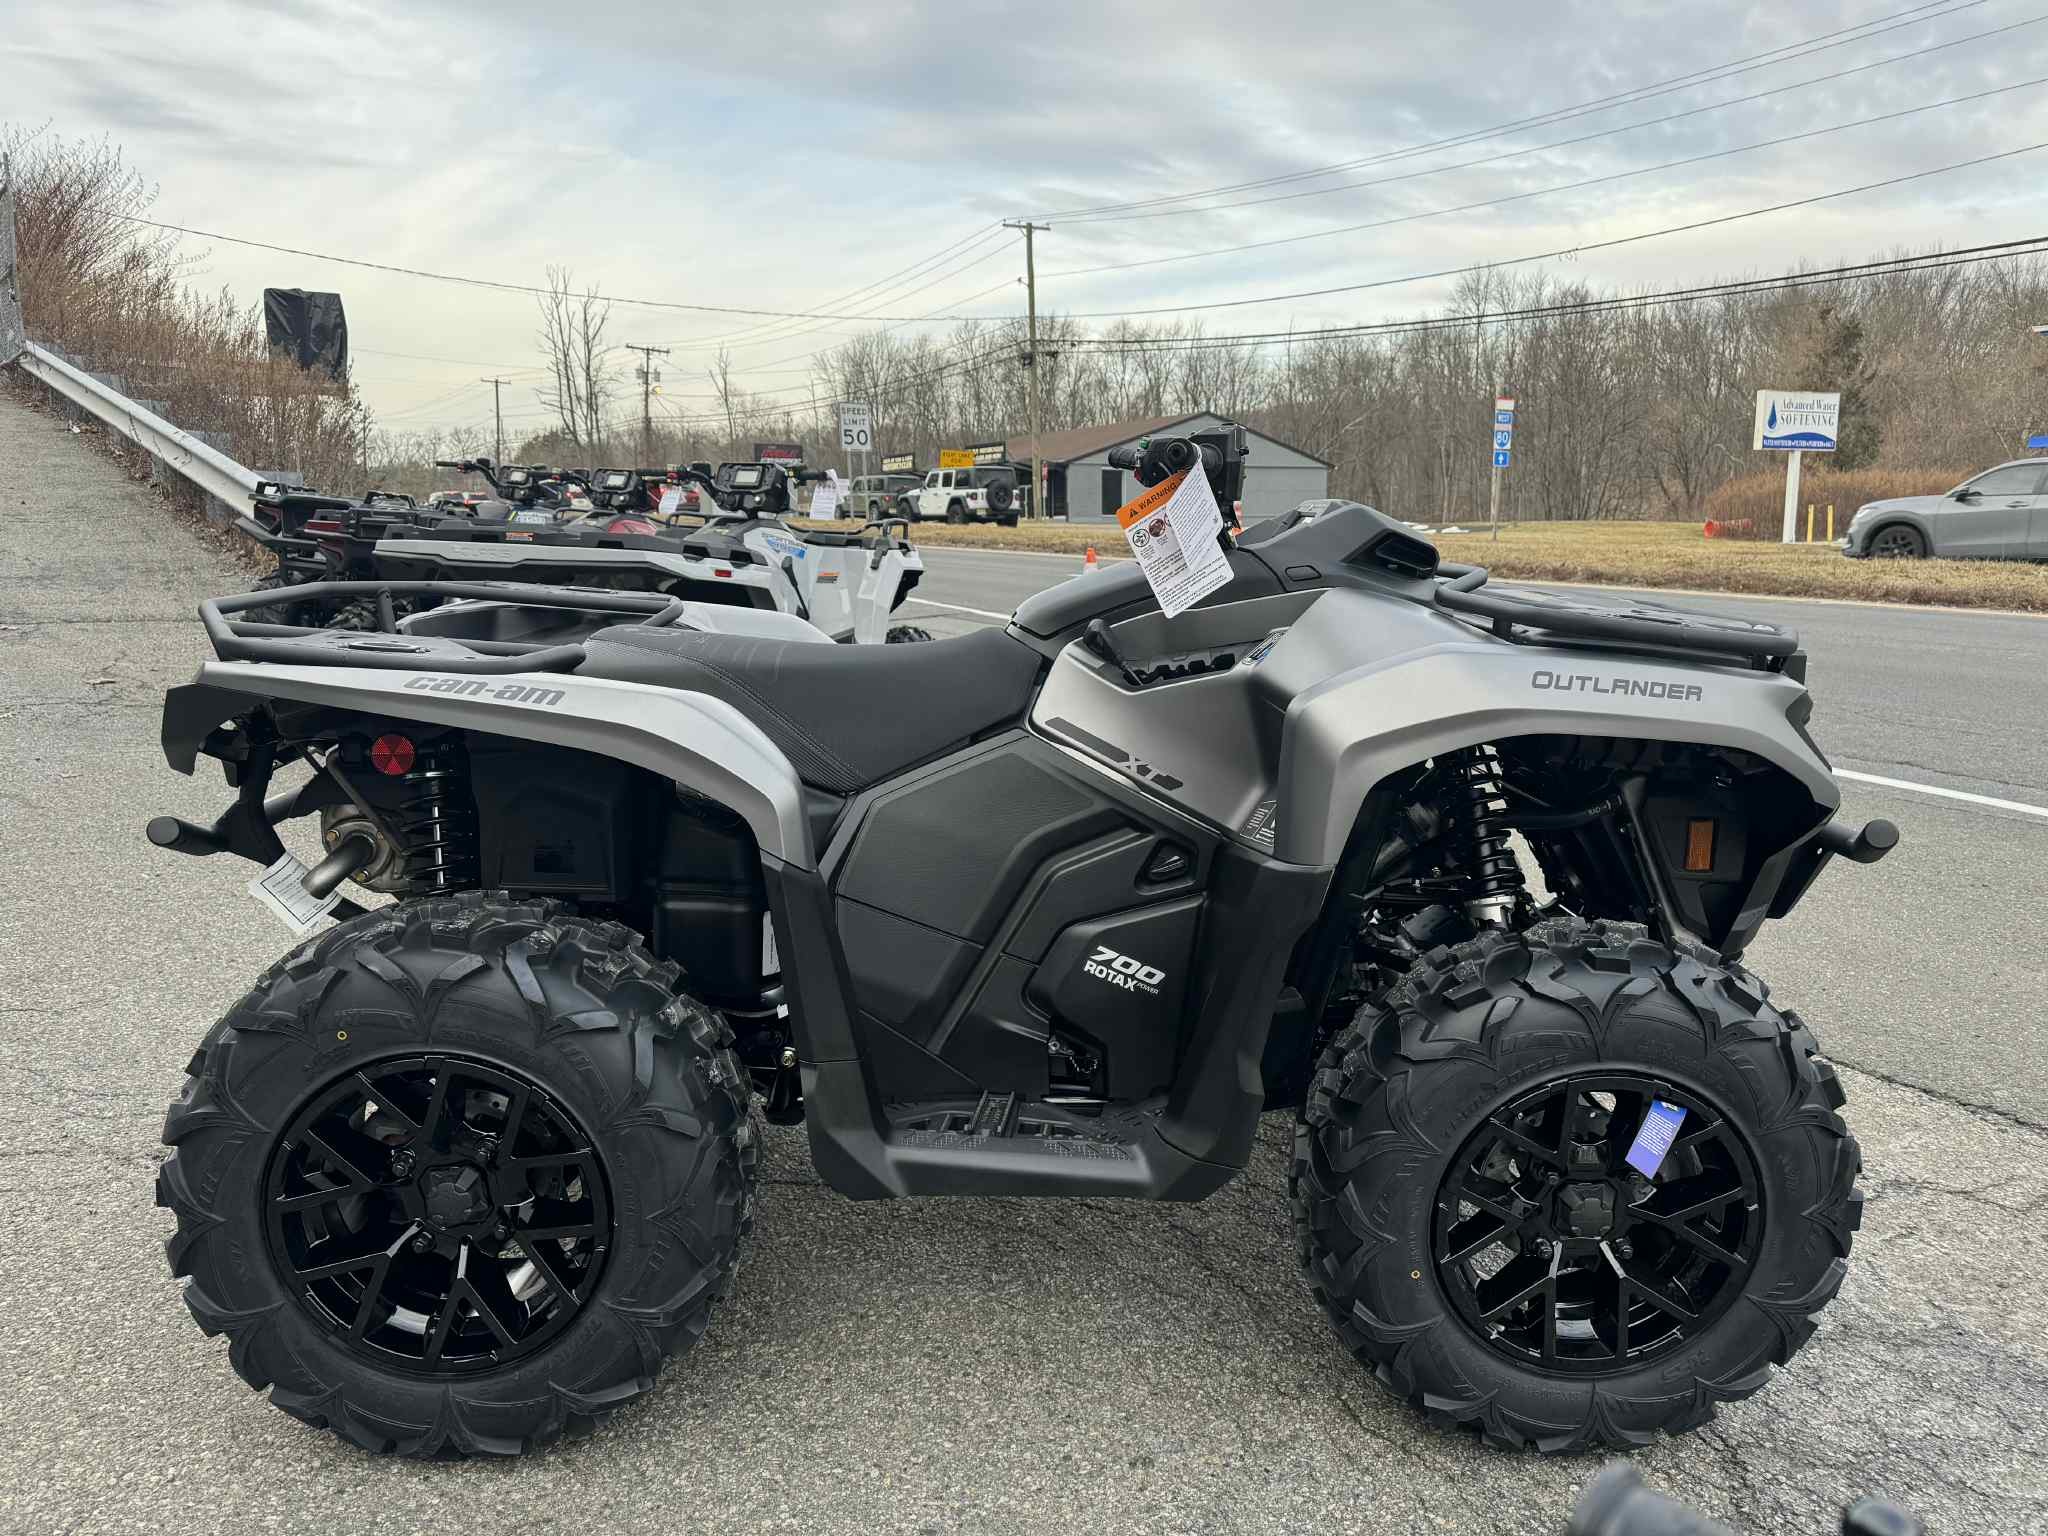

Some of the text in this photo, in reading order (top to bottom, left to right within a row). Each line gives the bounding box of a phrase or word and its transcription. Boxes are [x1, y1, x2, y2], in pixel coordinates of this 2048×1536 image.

[841, 407, 867, 416] SPEED
[1783, 398, 1837, 411] Advanced Water
[843, 418, 866, 426] LIMIT
[1779, 413, 1835, 426] SOFTENING
[843, 429, 869, 446] 50
[1496, 431, 1509, 444] 80
[1138, 482, 1178, 509] WARNING
[403, 676, 566, 706] can-am
[1531, 670, 1703, 702] OUTLANDER
[1089, 945, 1166, 985] 700
[1084, 960, 1138, 992] ROTAX
[1136, 982, 1159, 995] POWER
